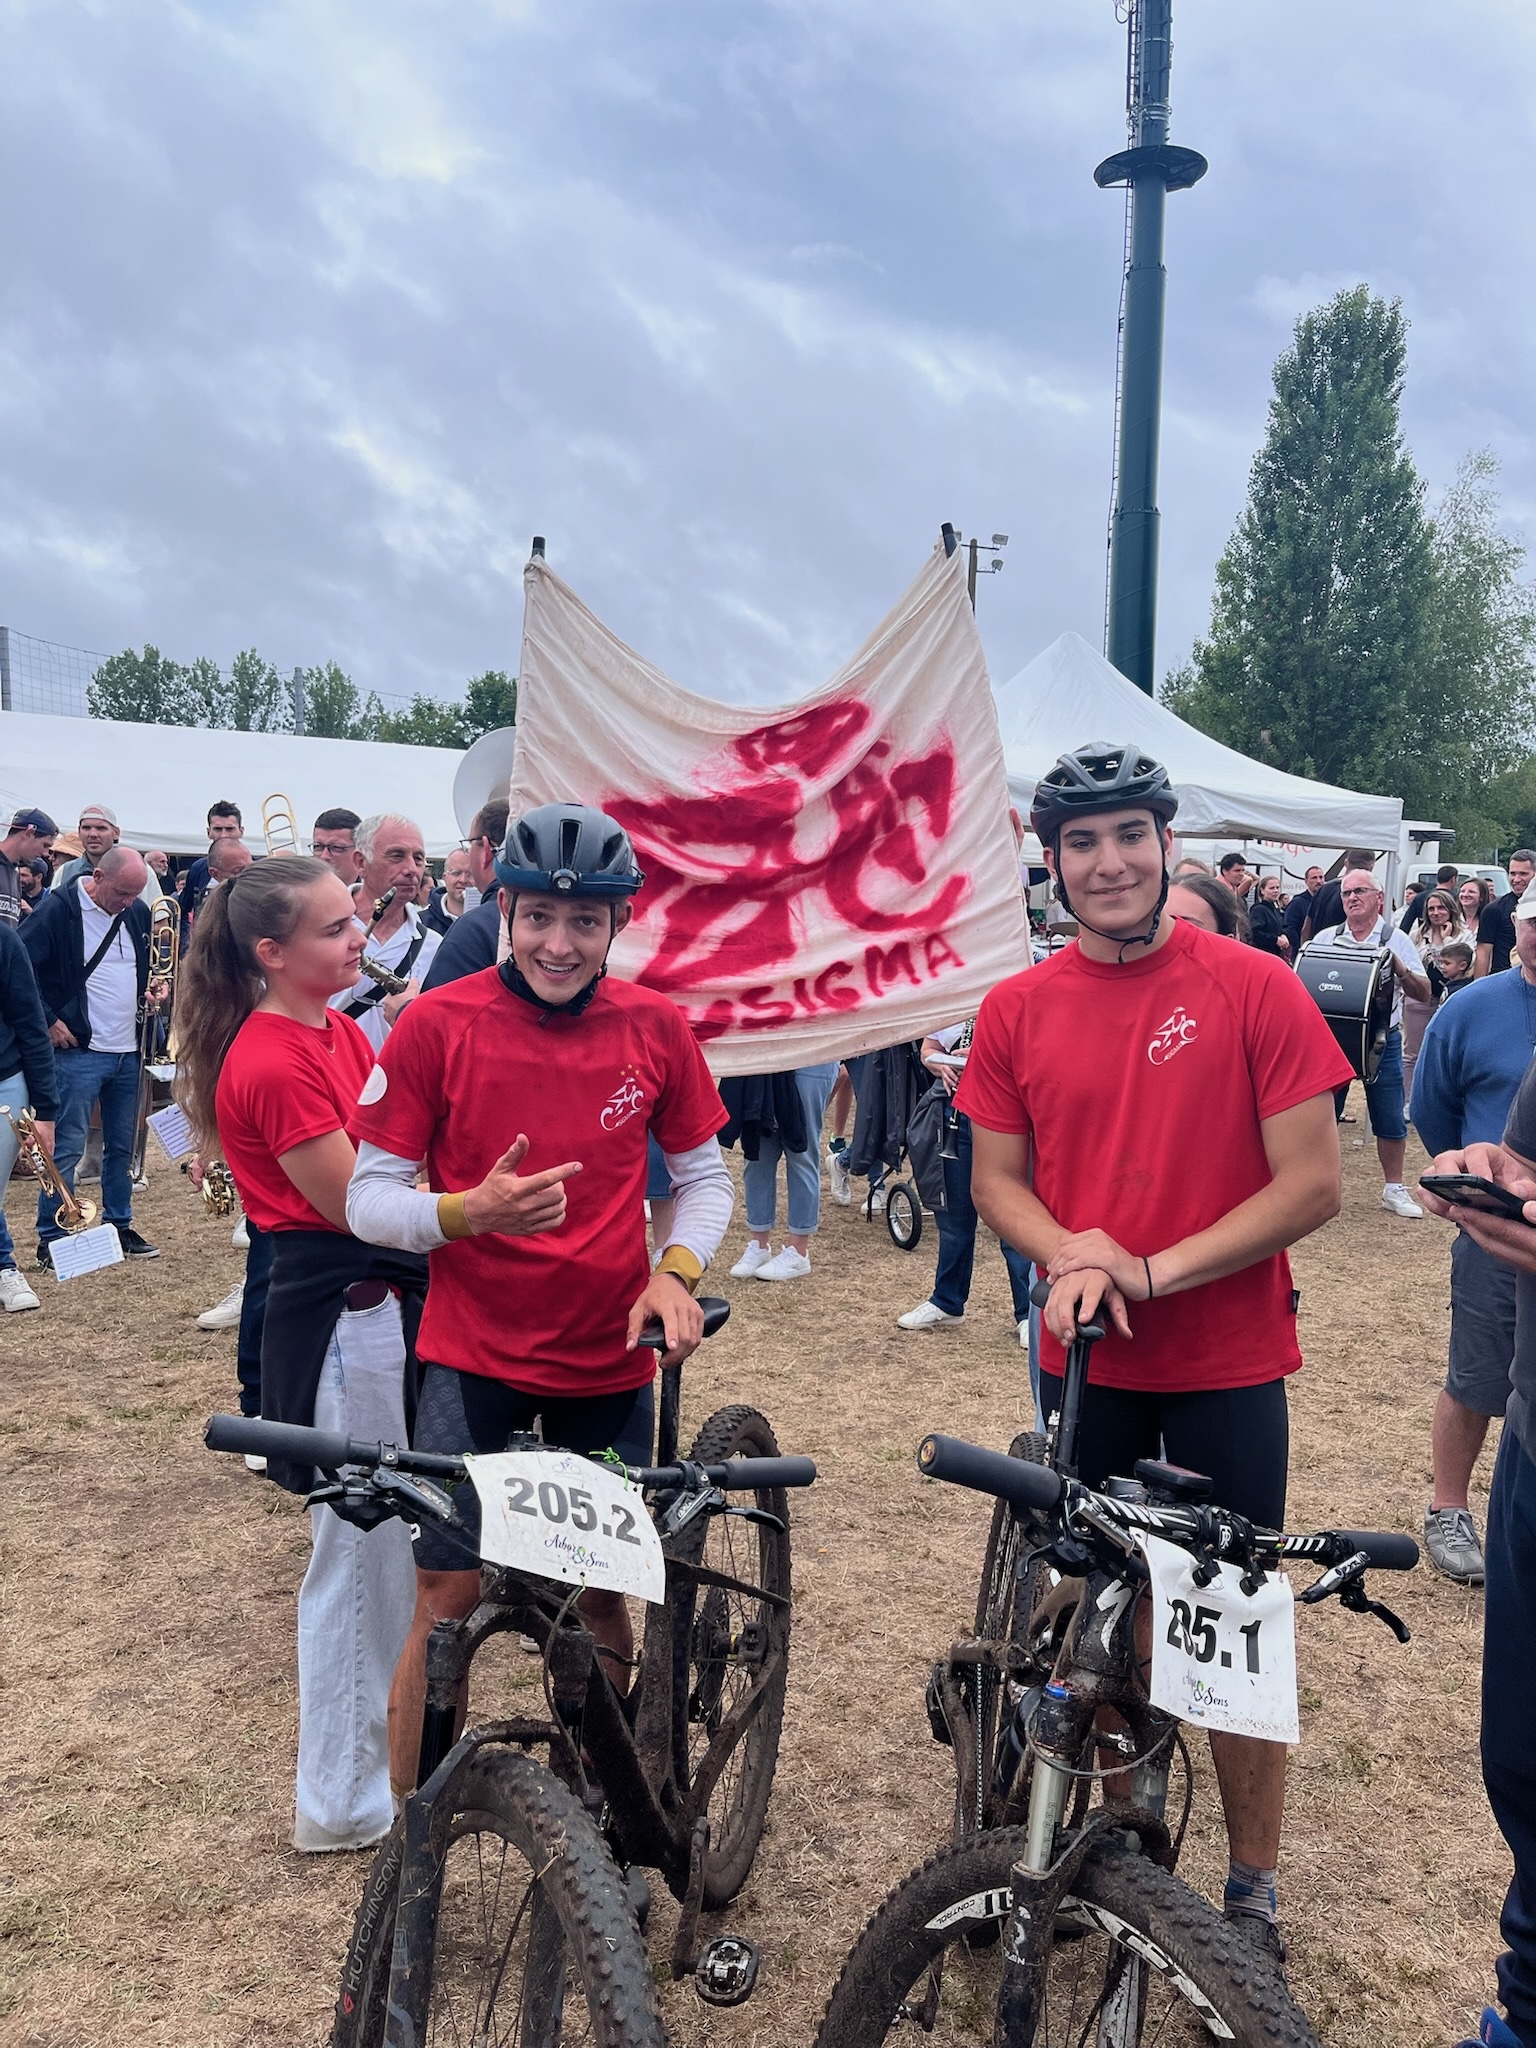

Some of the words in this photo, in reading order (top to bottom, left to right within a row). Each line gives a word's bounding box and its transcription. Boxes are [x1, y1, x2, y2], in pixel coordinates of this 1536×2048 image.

[503, 1476, 642, 1546] 205.2
[585, 1551, 609, 1569] Sens
[1204, 1686, 1229, 1708] Sens
[346, 1849, 400, 1992] HUTCHINSON
[935, 1899, 976, 1924] CONTROL
